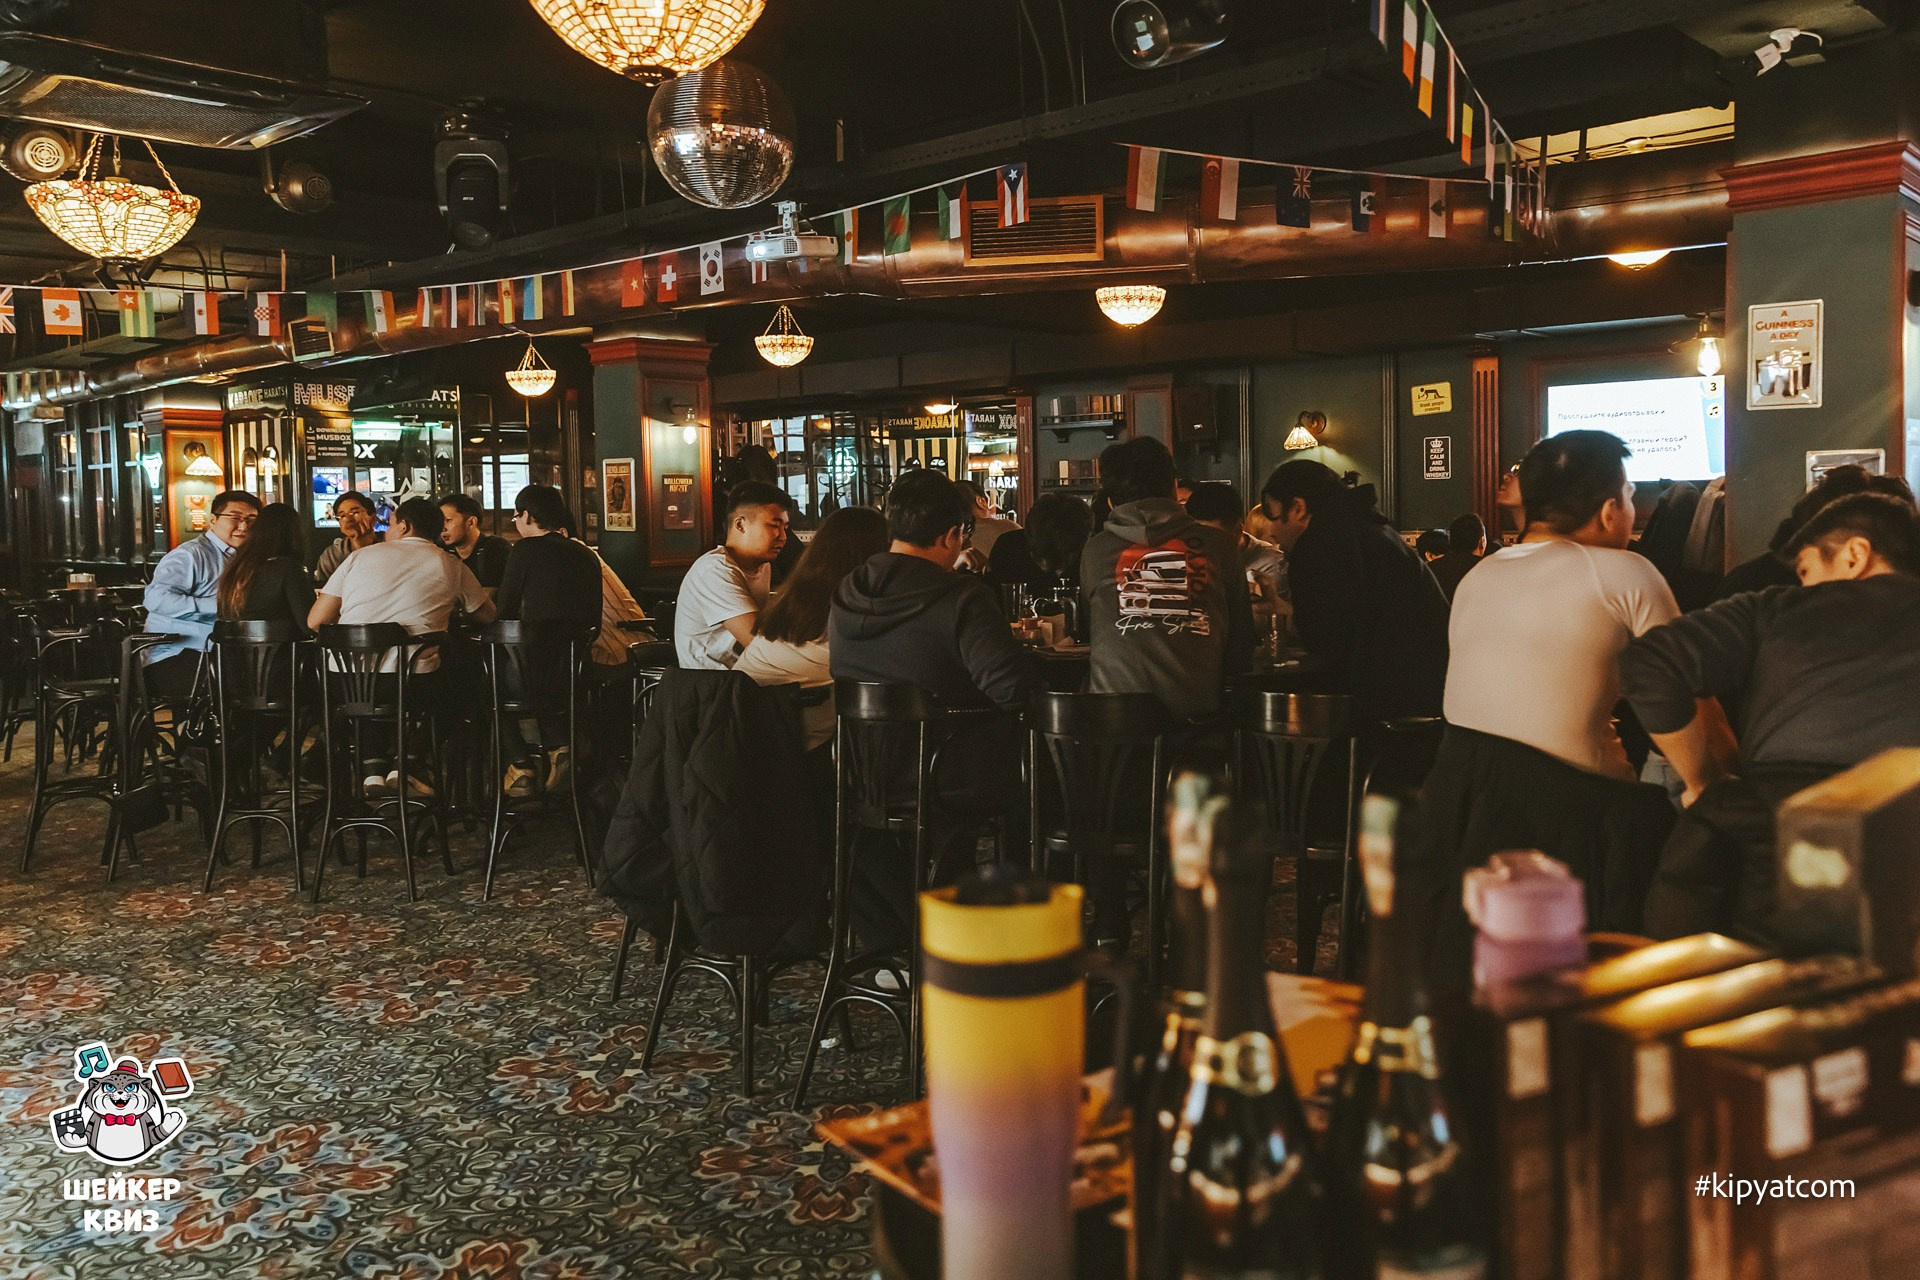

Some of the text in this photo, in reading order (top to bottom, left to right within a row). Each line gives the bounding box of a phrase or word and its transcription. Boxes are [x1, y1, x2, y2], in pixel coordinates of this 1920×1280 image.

[1756, 320, 1814, 330] GUINNESS
[264, 386, 285, 398] HARATS
[1710, 382, 1718, 391] 3
[428, 389, 458, 402] ATS
